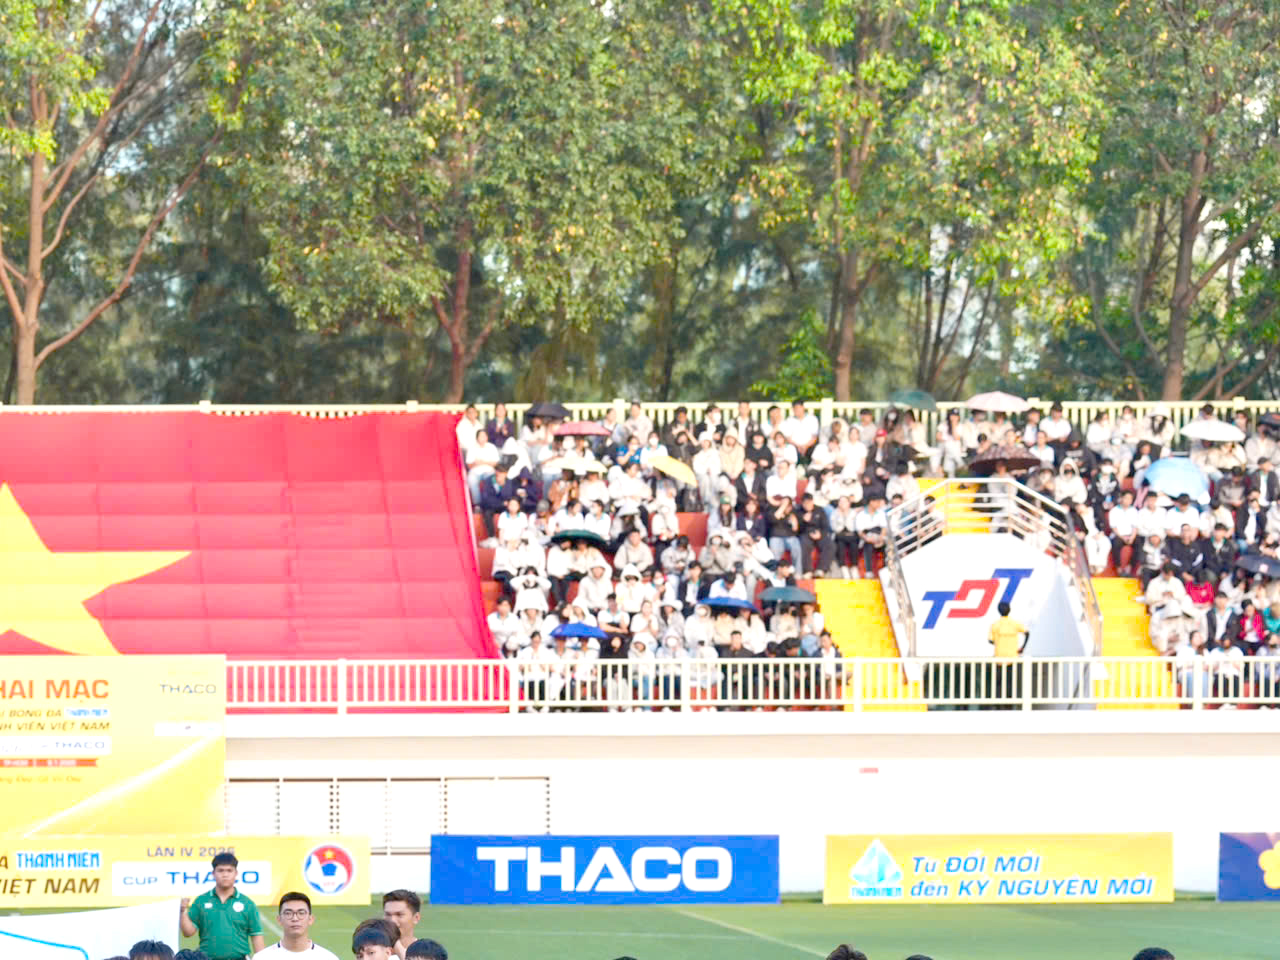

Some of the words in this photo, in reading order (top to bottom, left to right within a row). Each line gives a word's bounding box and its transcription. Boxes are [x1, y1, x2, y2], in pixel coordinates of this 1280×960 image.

[159, 684, 217, 694] THACO
[80, 721, 110, 731] NAM
[55, 741, 105, 750] THACO
[180, 847, 194, 857] IV
[476, 846, 733, 892] THACO
[166, 871, 259, 885] THAO
[44, 878, 100, 894] NAM
[998, 875, 1099, 896] NGUYÊN
